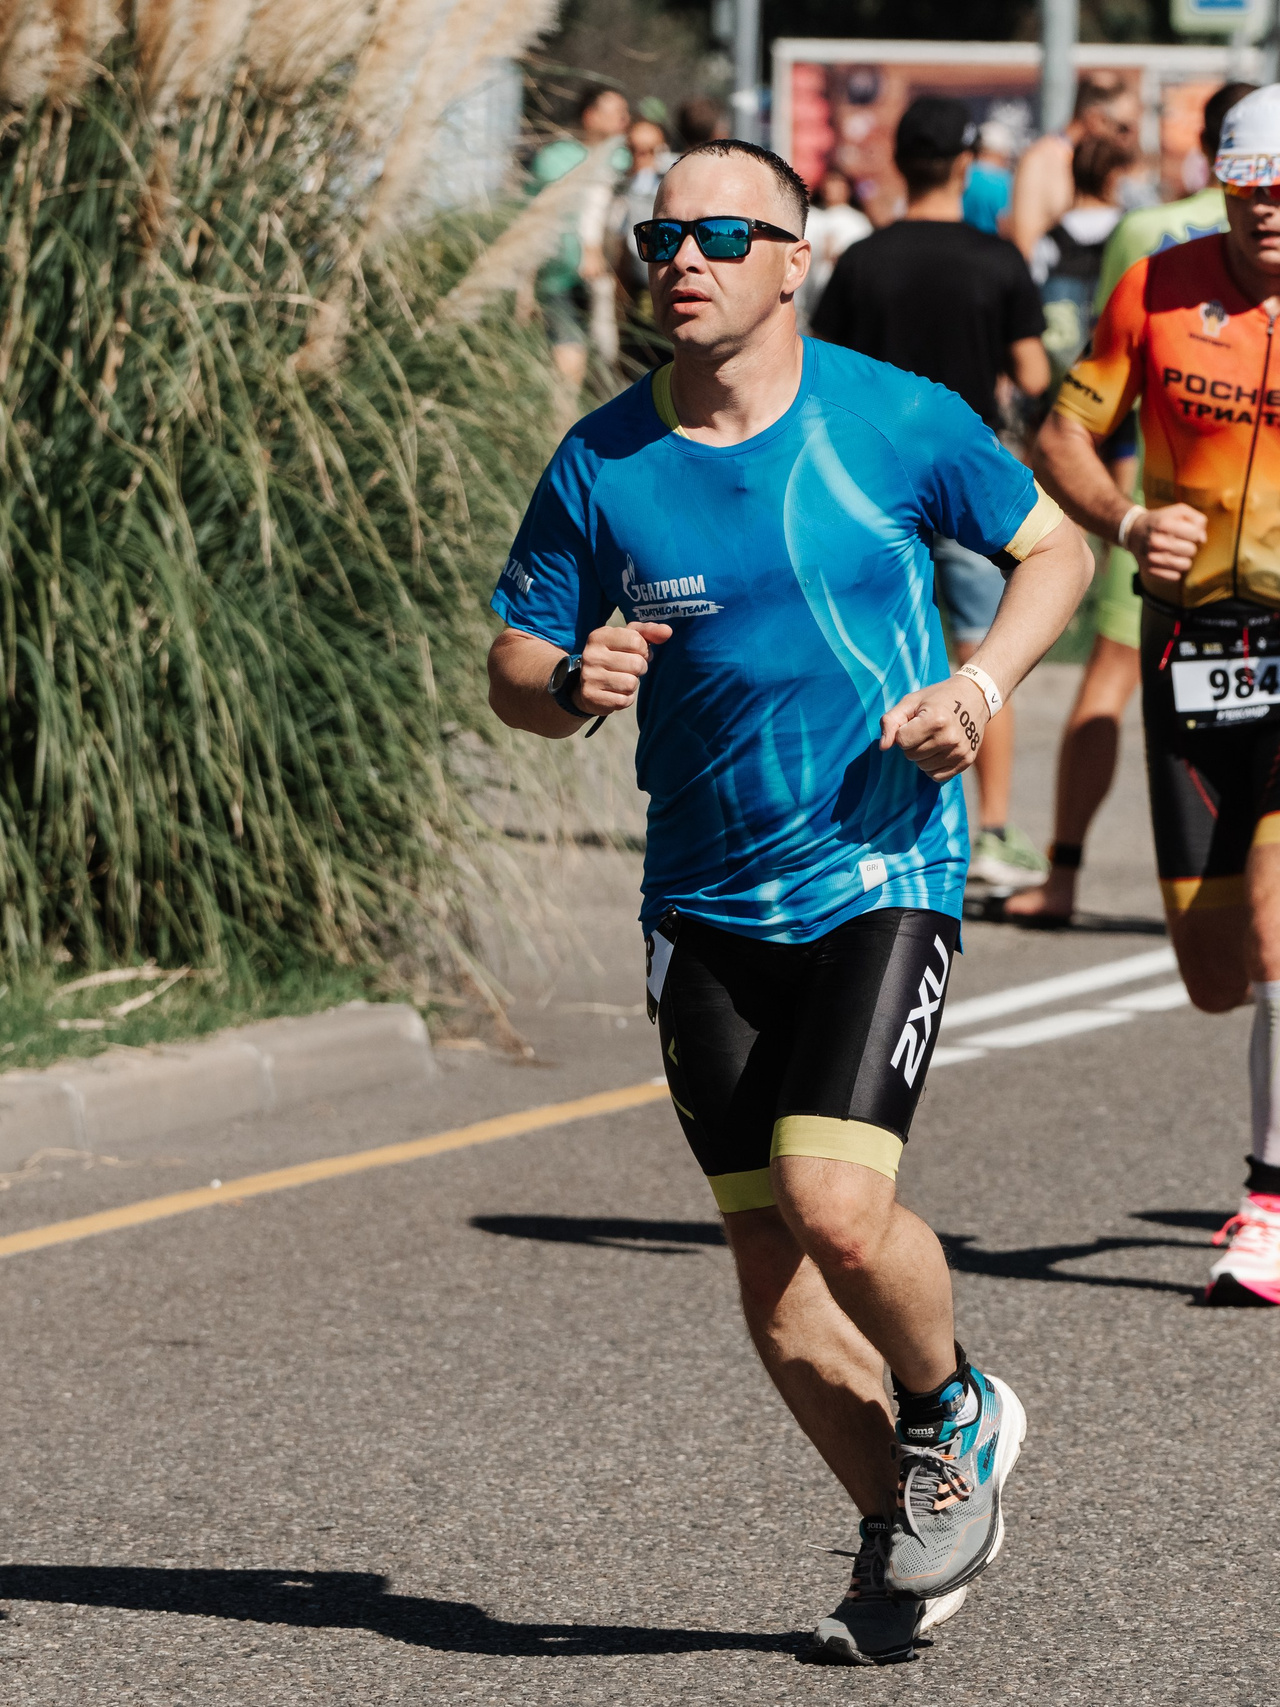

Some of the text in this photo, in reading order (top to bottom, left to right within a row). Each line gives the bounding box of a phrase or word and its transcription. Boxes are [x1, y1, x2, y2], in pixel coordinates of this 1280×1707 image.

[639, 574, 706, 602] GAZPROM
[639, 603, 711, 618] TRIATHLON TEAM
[1209, 663, 1280, 701] 984
[954, 699, 980, 752] 1088
[889, 933, 950, 1090] 2XU
